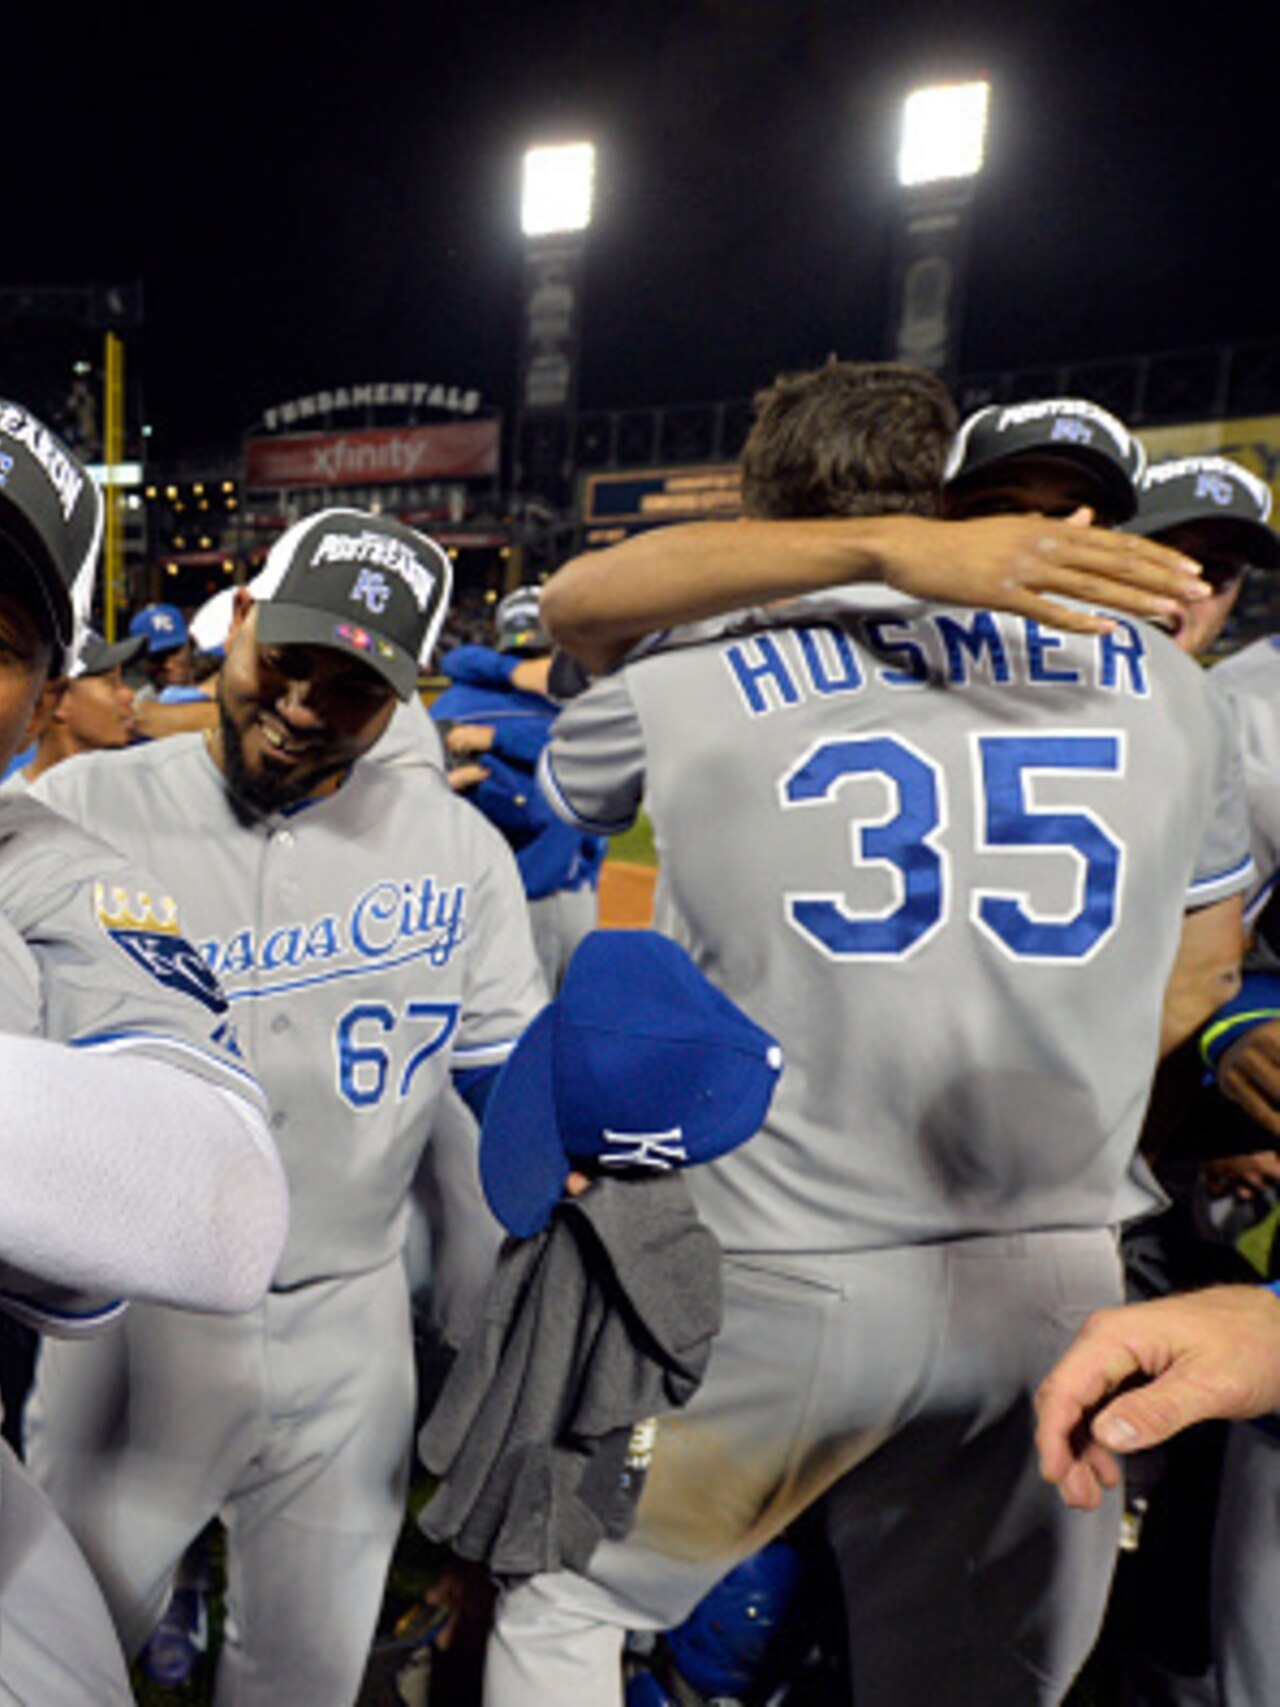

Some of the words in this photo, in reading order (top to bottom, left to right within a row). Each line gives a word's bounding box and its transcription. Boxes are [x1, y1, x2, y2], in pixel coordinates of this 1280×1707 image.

[263, 382, 481, 430] FUNDAMENTALS
[312, 438, 429, 481] xfinity
[350, 567, 392, 615] KC
[720, 606, 1150, 718] HOSMER
[776, 730, 1128, 966] 35
[349, 871, 470, 969] City
[333, 999, 464, 1112] 67
